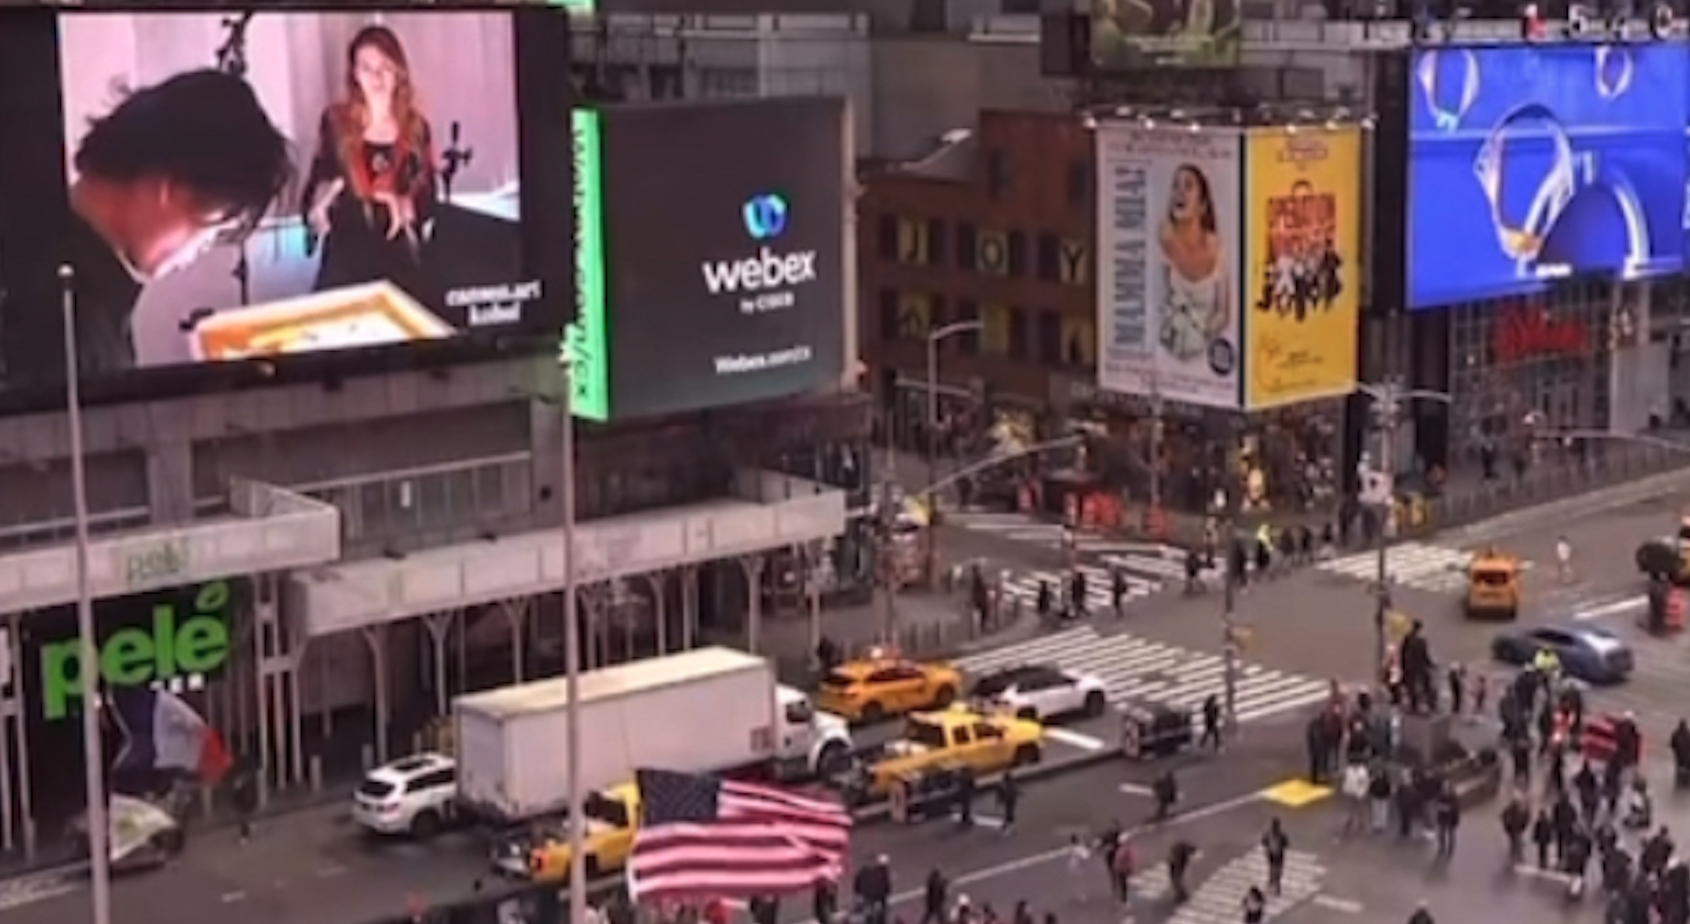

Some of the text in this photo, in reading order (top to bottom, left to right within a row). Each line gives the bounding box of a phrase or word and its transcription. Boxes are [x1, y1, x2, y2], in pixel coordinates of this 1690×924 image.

[702, 246, 817, 294] webex
[1113, 241, 1146, 346] MAMMA
[41, 581, 231, 720] pelé
